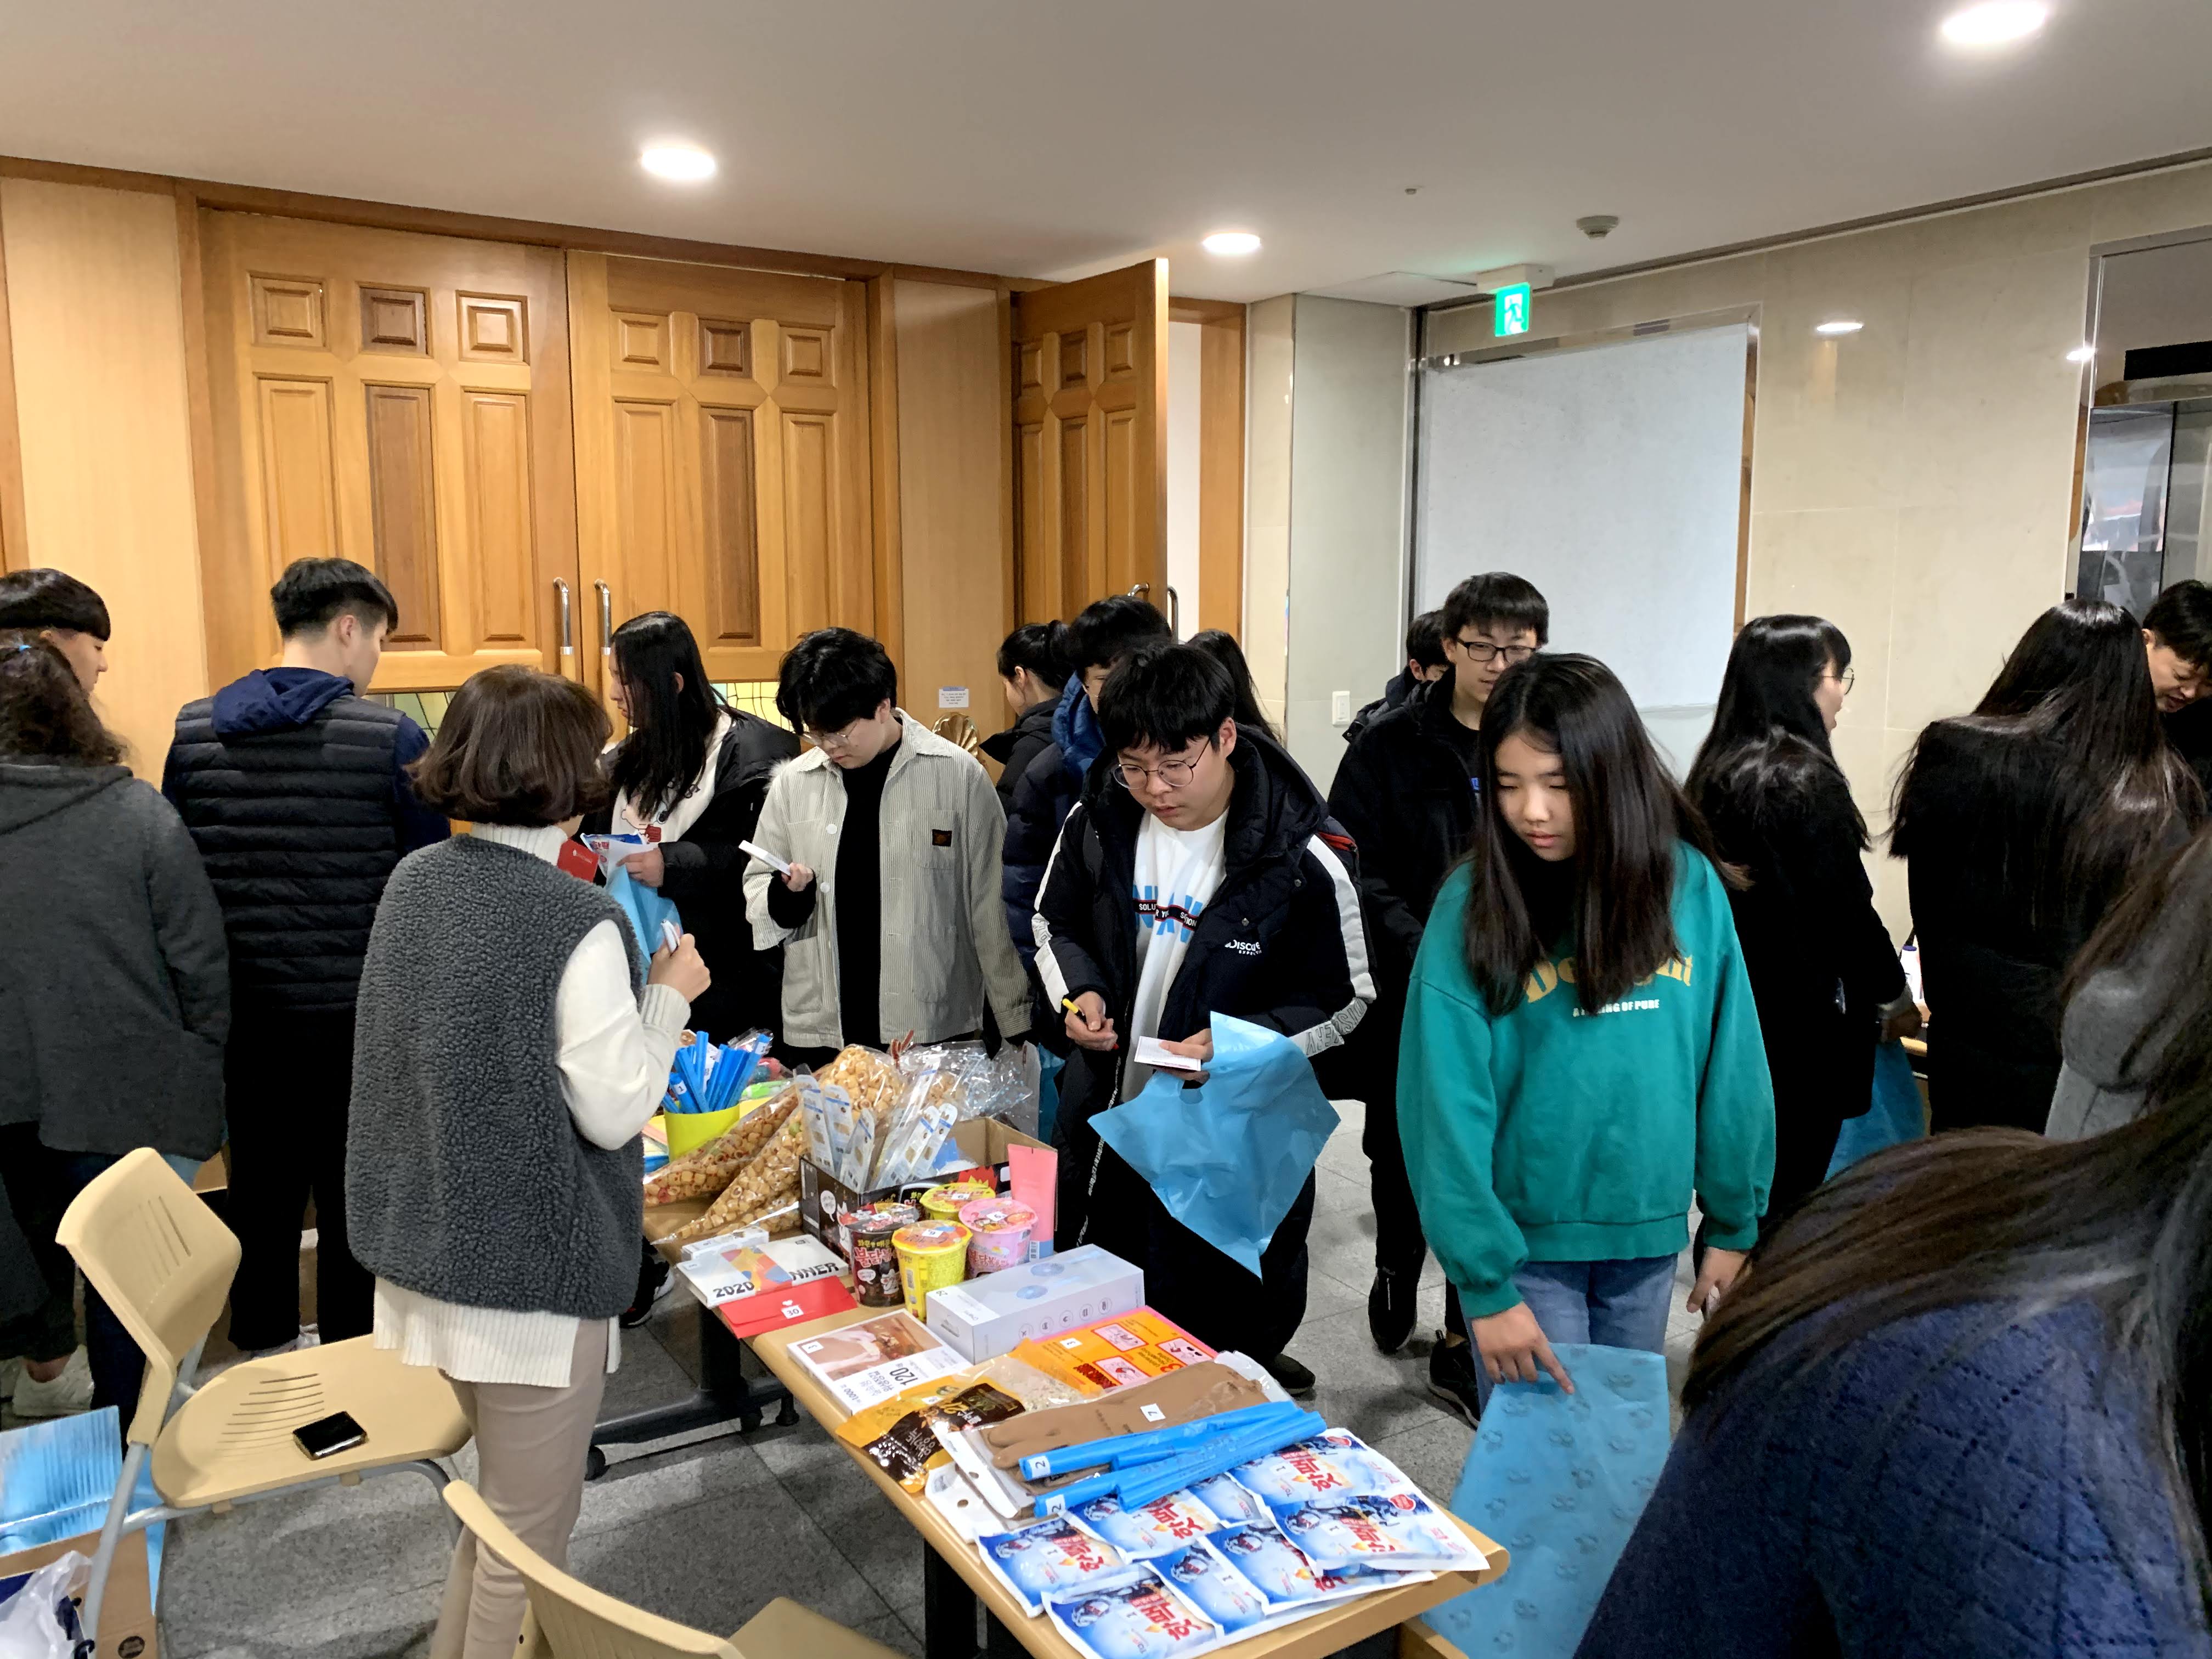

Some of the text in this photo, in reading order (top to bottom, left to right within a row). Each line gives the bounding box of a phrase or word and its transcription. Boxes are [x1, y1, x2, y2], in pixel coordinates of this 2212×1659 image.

[1622, 1001, 1633, 1012] OF
[1634, 998, 1660, 1010] PURE
[713, 1281, 755, 1298] 2020
[786, 1307, 800, 1317] 30
[1035, 1459, 1046, 1470] 2
[1290, 1458, 1343, 1492] 핫팩
[1051, 1503, 1062, 1513] 2
[1147, 1503, 1205, 1539] 핫팩
[1060, 1543, 1104, 1573] 핫팩
[1140, 1601, 1203, 1641] 핫팩
